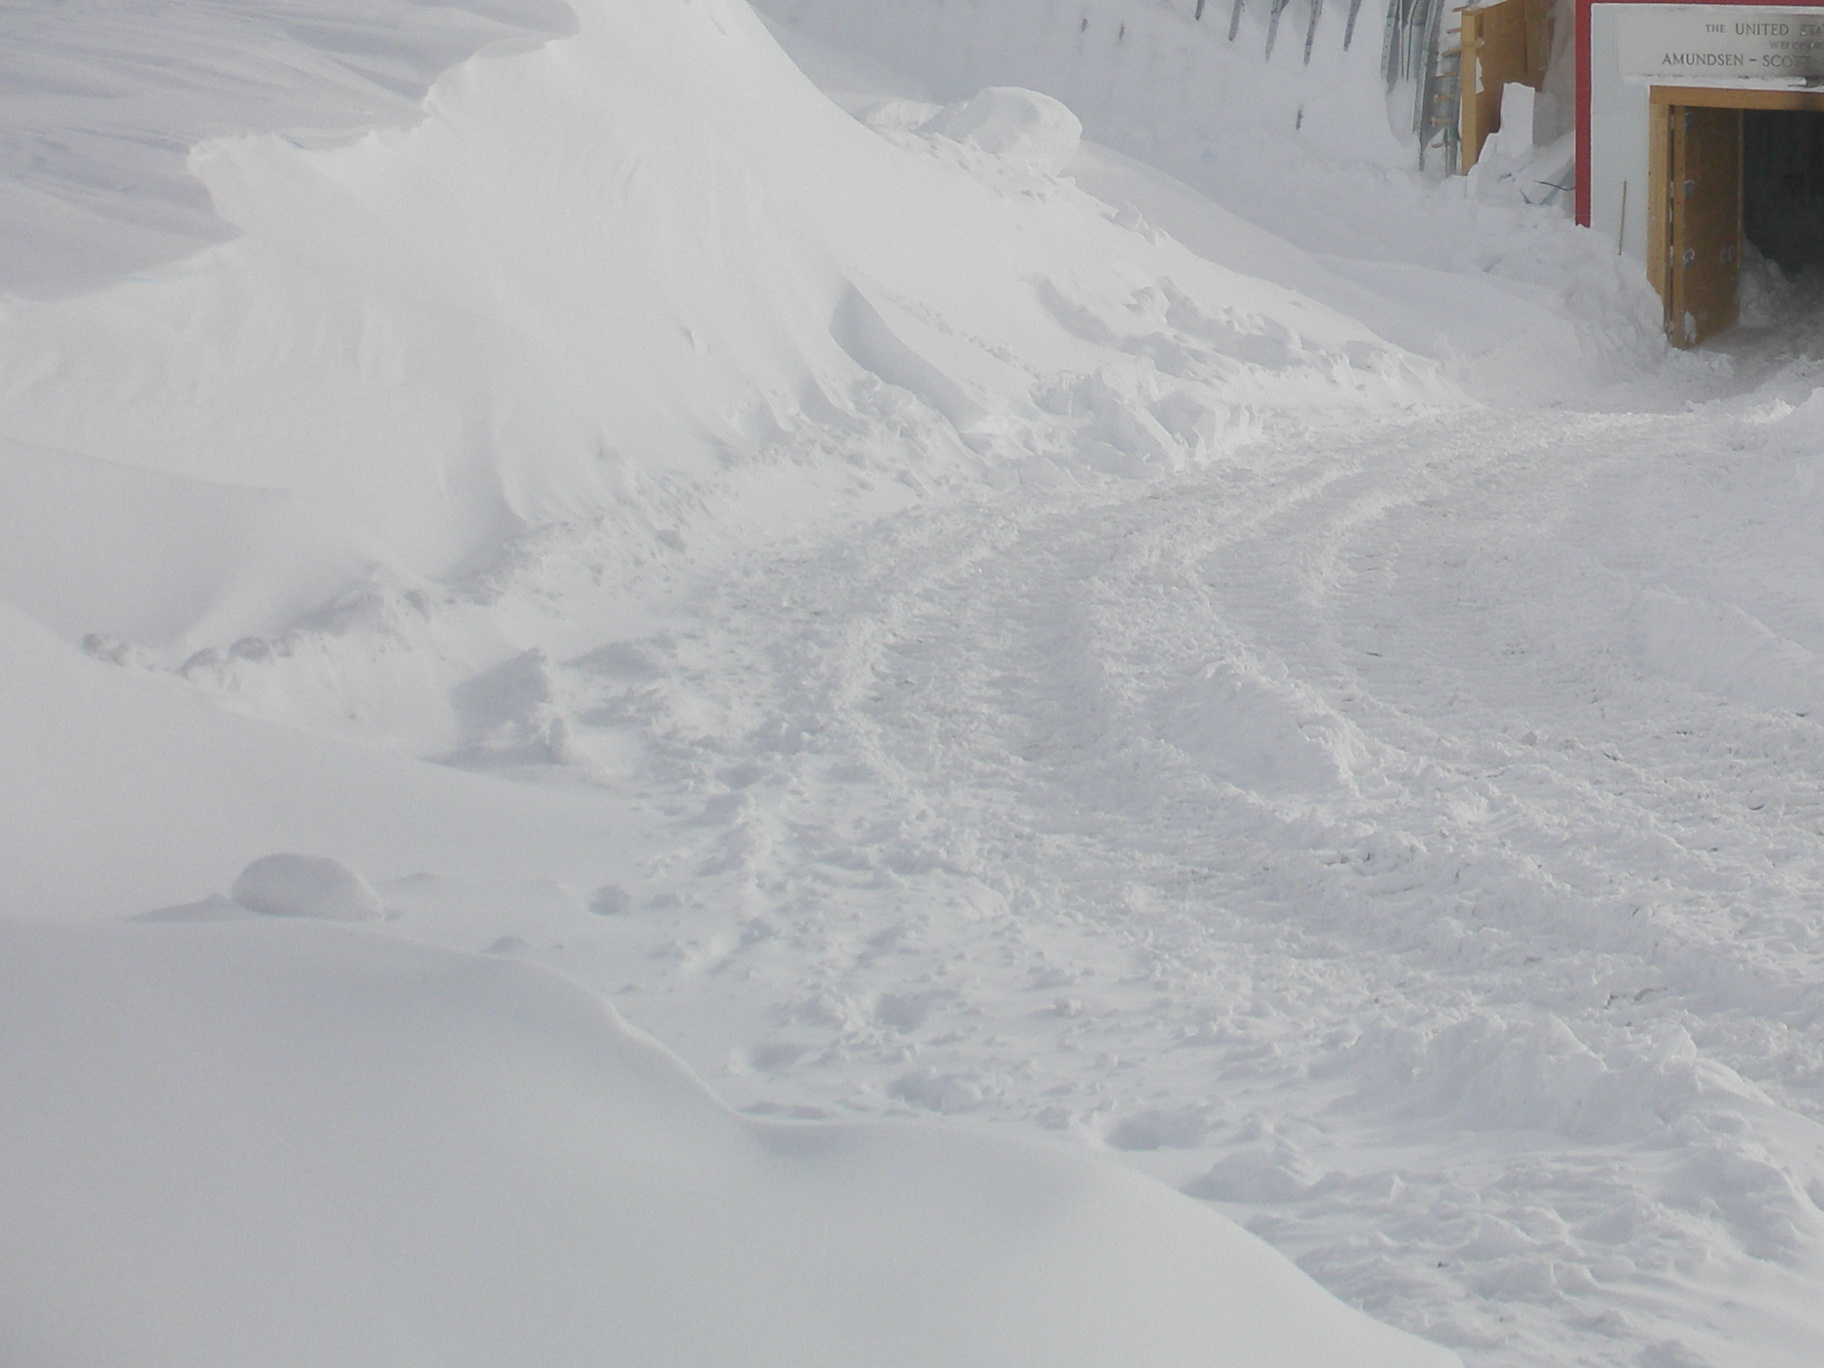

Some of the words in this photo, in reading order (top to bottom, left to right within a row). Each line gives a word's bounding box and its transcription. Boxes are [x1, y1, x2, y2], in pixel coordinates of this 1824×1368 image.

[1705, 24, 1726, 34] THE
[1735, 23, 1790, 36] UNITED
[1662, 53, 1744, 67] AMUNDSEN
